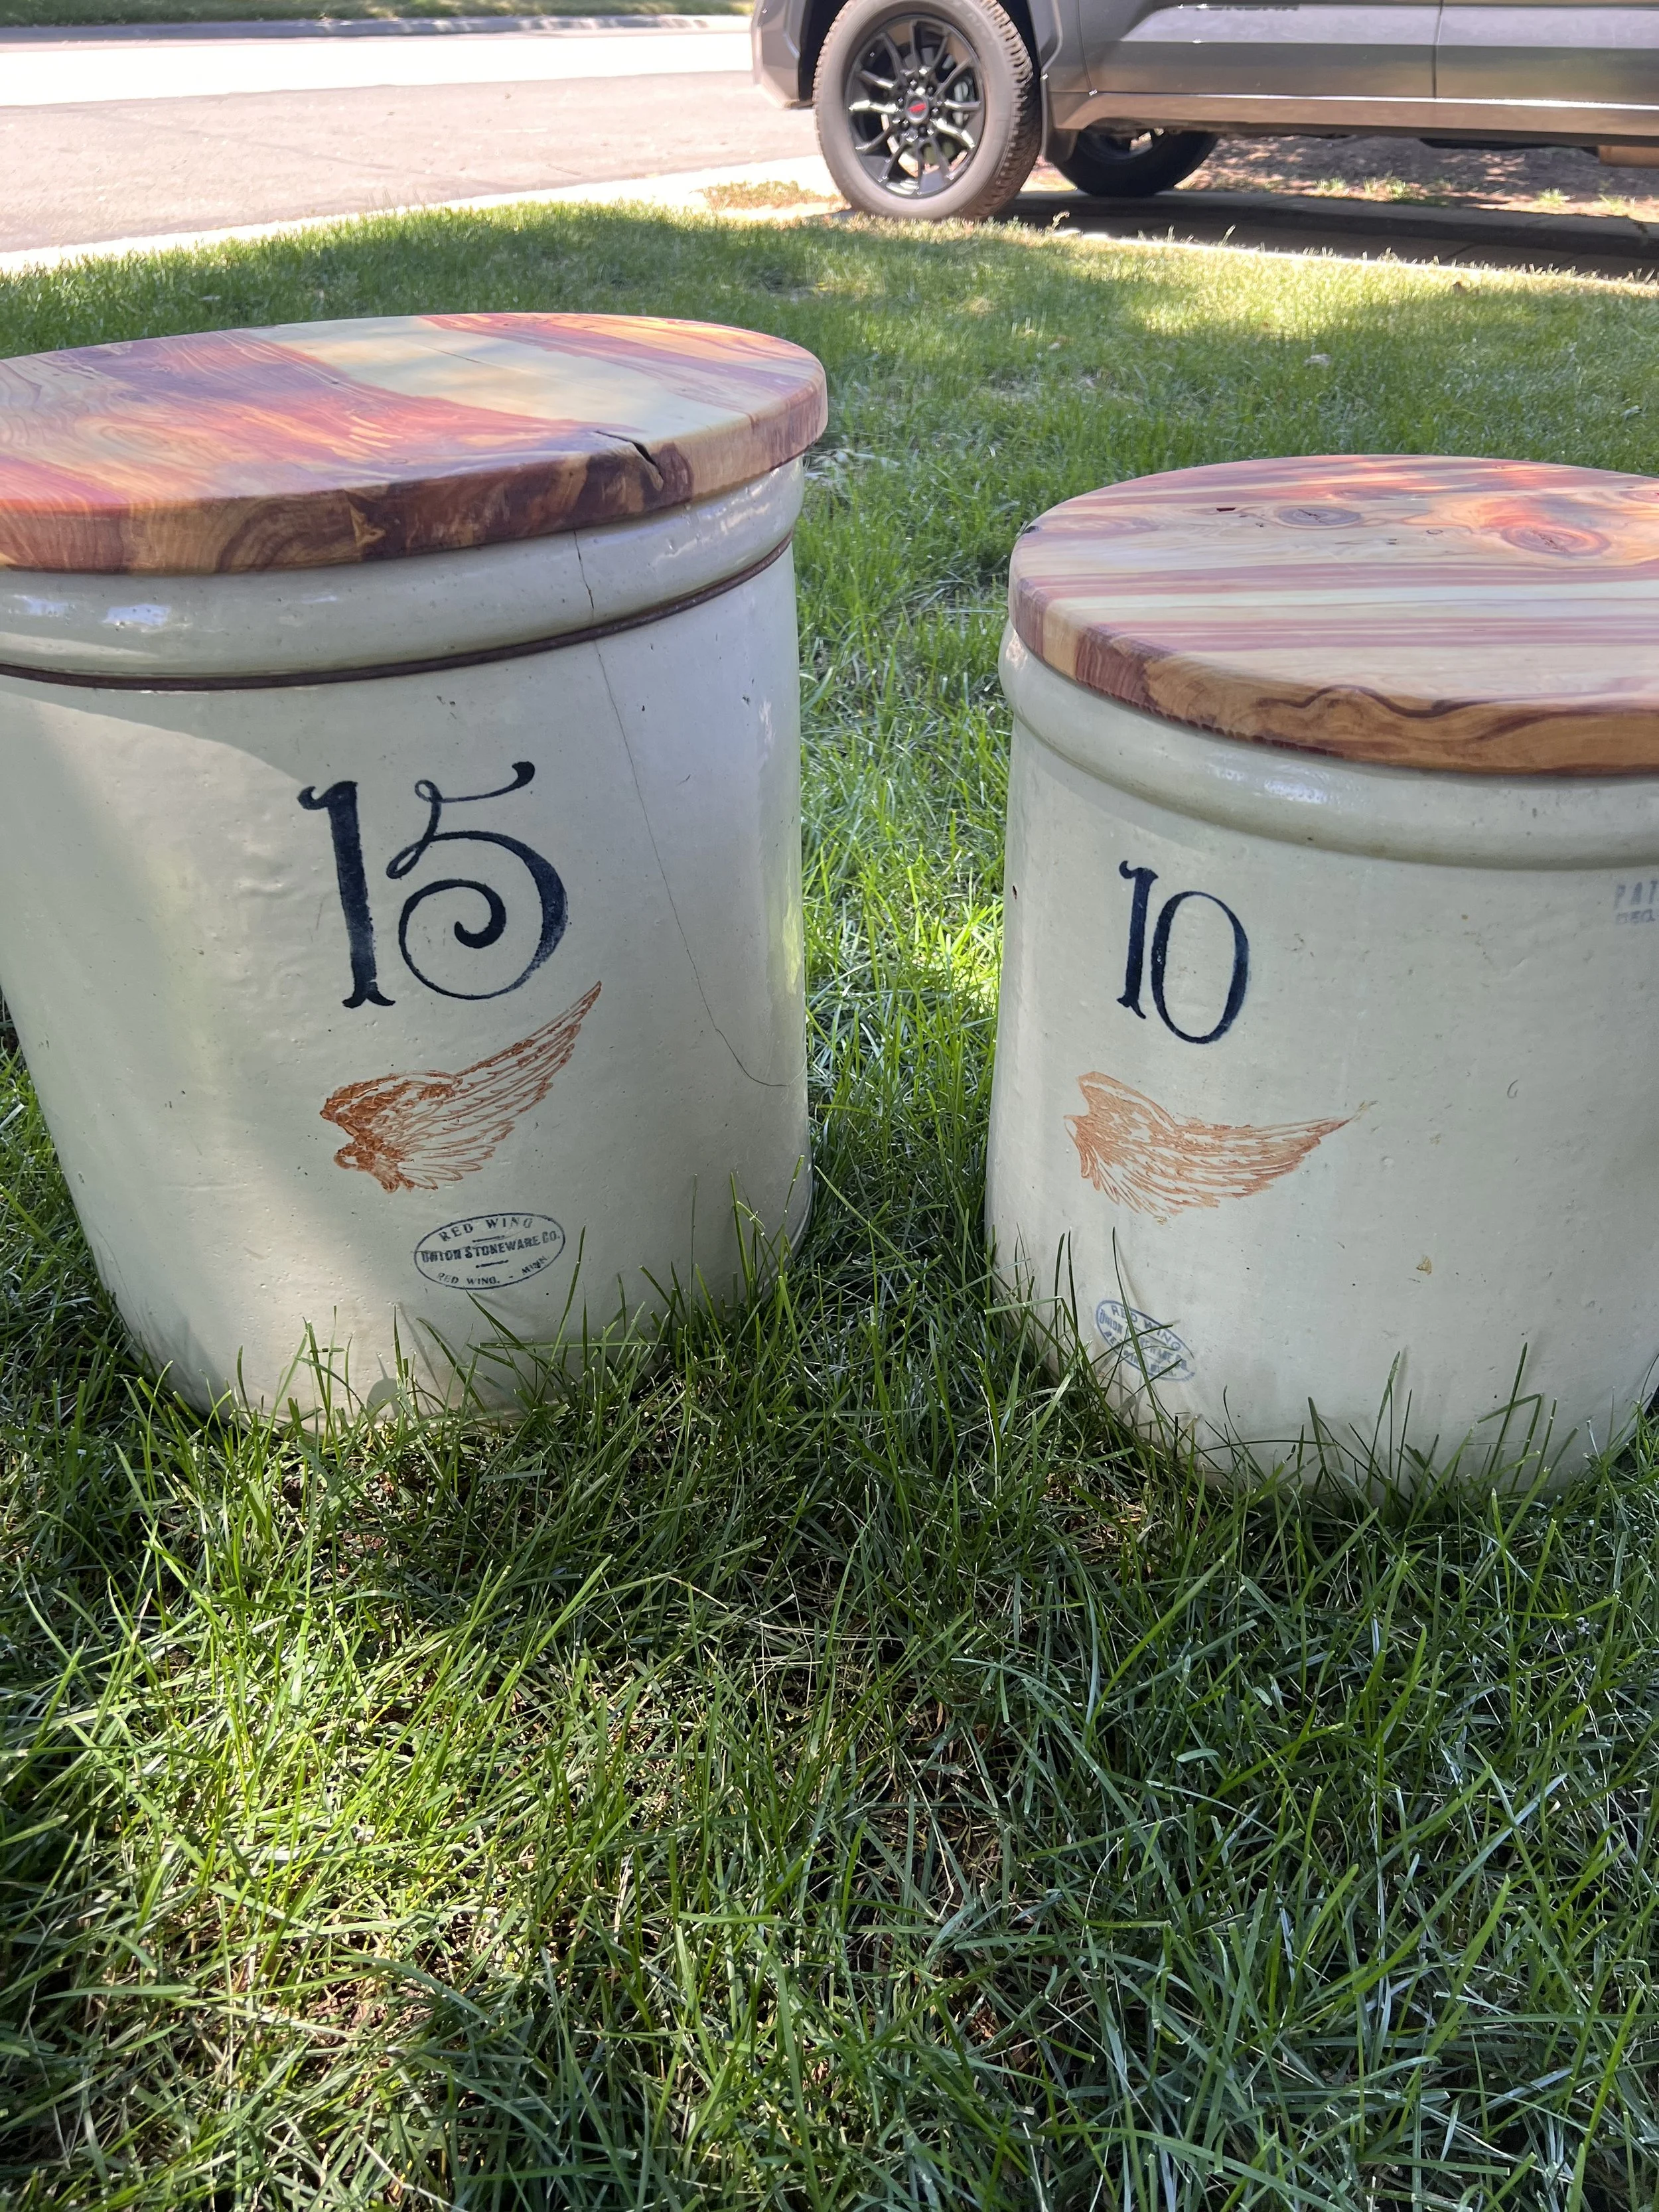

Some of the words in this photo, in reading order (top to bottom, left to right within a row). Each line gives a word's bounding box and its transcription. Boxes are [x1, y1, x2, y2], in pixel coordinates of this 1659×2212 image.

[297, 761, 568, 1008] 15
[1116, 861, 1250, 1044] 10
[438, 1223, 473, 1242] RED
[486, 1217, 534, 1228] WING
[465, 1236, 541, 1259] STONEWARE
[437, 1272, 459, 1284] RED
